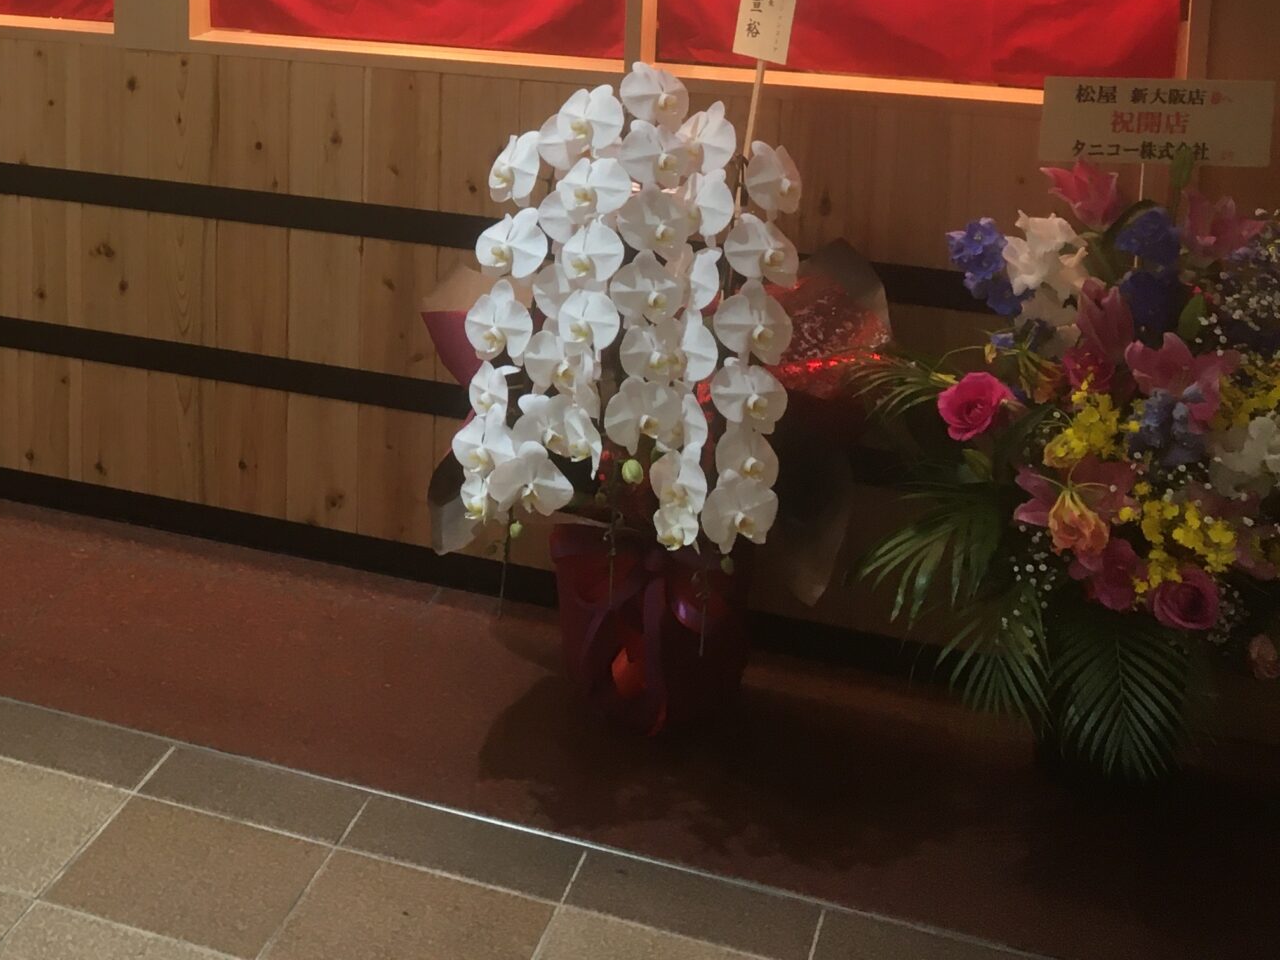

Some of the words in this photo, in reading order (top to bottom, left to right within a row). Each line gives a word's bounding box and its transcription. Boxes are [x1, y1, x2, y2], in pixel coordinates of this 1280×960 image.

[1075, 84, 1118, 104] 松屋
[1130, 87, 1207, 106] 新大阪店
[1110, 110, 1190, 134] 祝開店
